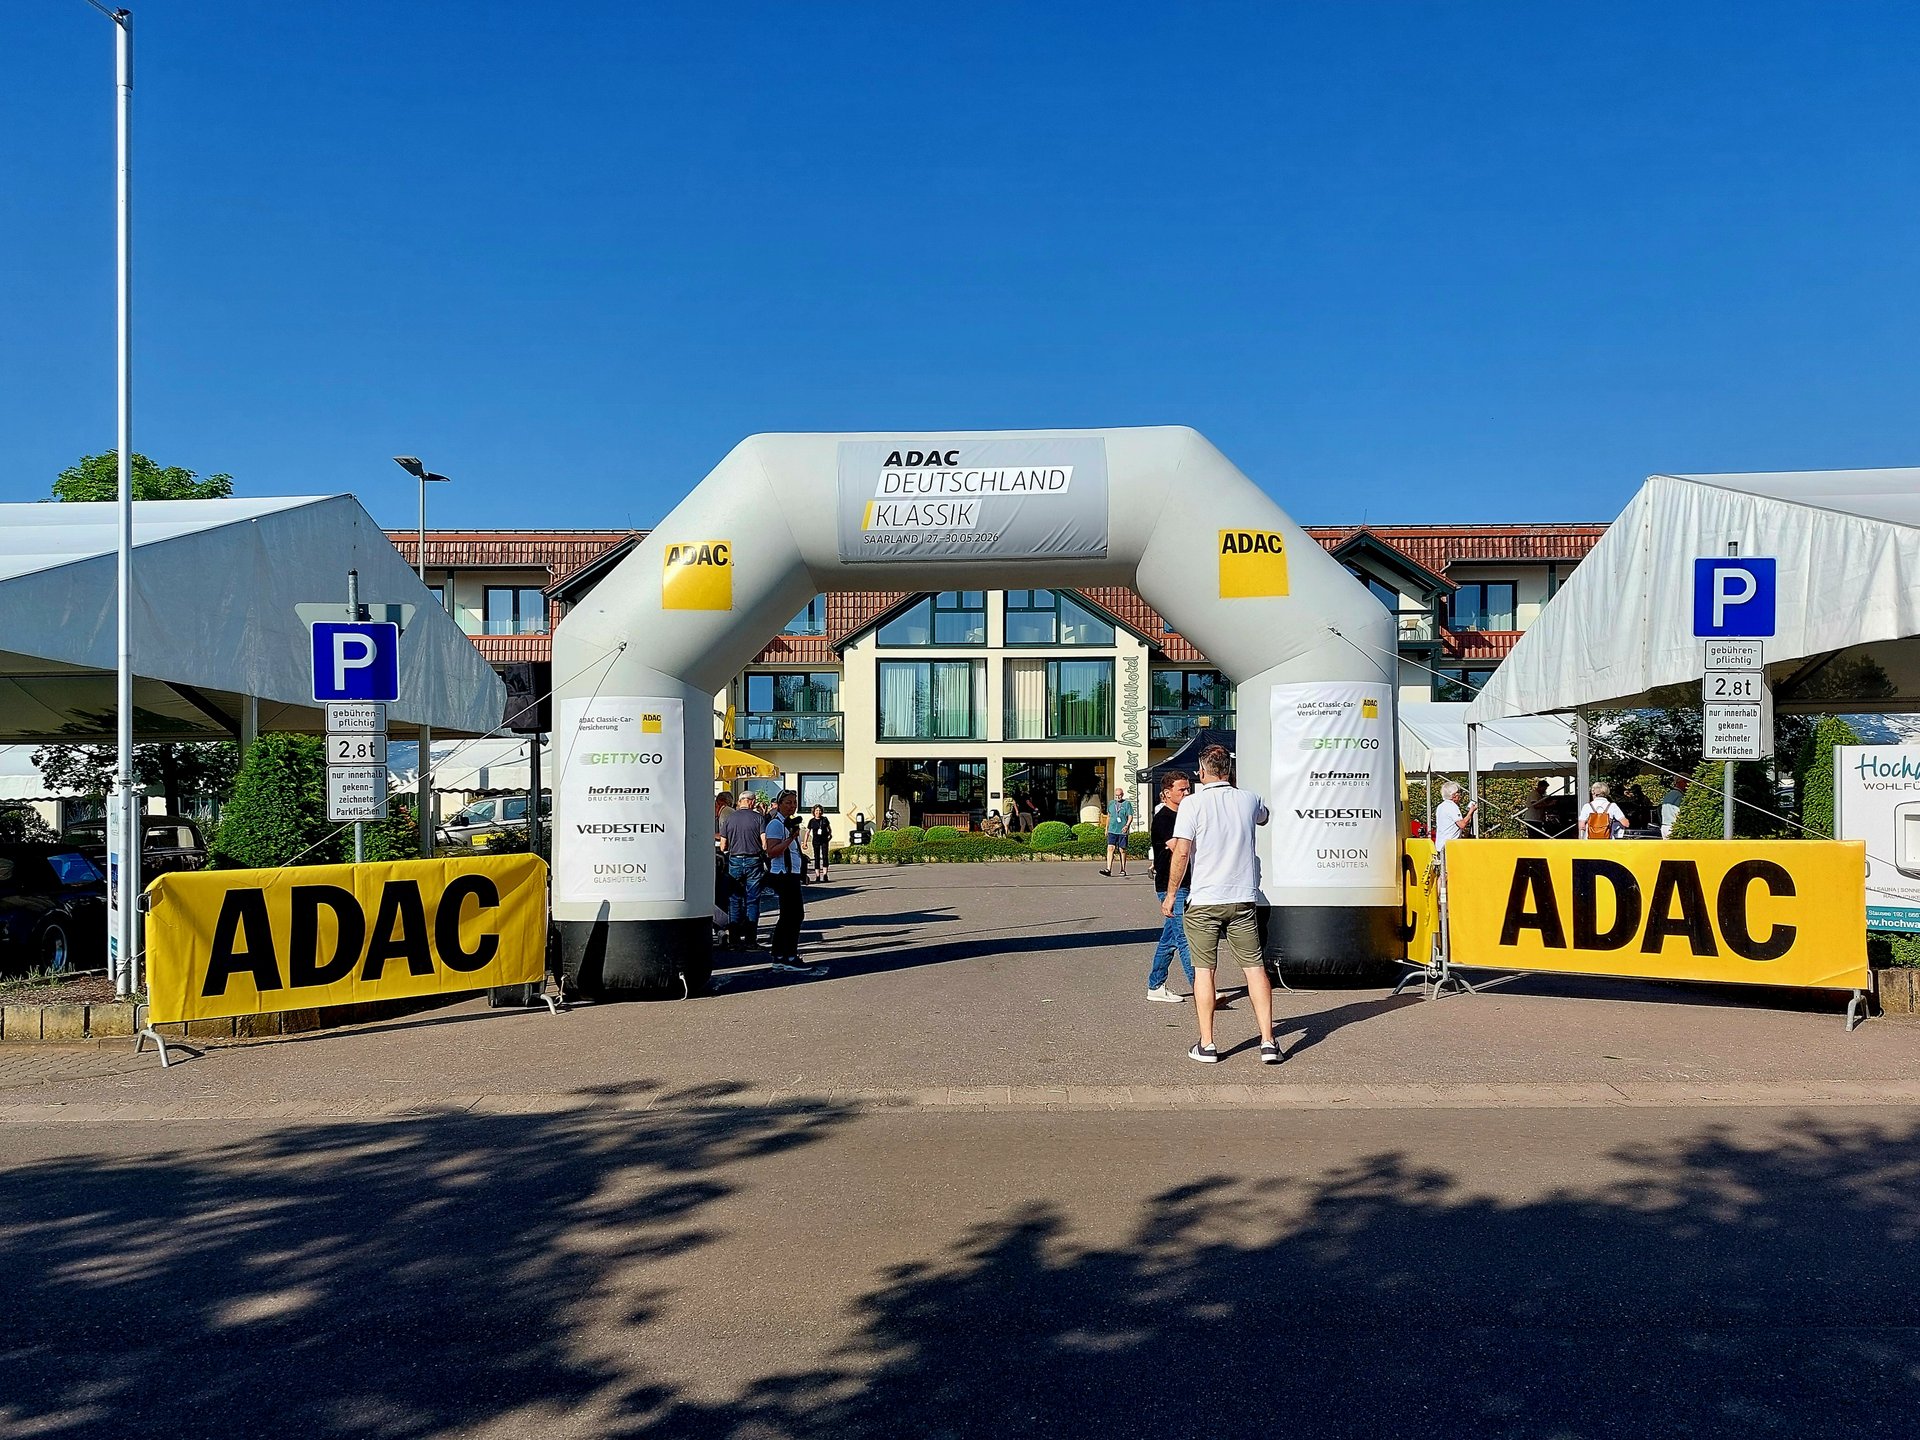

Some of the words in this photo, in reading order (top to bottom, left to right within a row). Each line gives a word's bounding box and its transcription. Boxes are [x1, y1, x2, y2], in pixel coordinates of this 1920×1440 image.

[883, 450, 960, 467] ADAC
[884, 469, 1065, 494] DEUTSCHLAND
[876, 502, 975, 527] KLASSIK
[864, 533, 918, 545] SAARLAND
[1222, 533, 1282, 554] ADAC
[666, 544, 729, 567] ADAC
[1712, 567, 1757, 628] P
[1711, 645, 1757, 656] gebühren-
[332, 632, 378, 691] P
[1716, 656, 1752, 666] pflichtig
[1118, 655, 1146, 748] Wohlfühlhotel
[1362, 699, 1378, 707] ADAC
[332, 709, 381, 719] gebühren-
[642, 714, 662, 722] ADAC
[1297, 709, 1342, 717] Versicherung
[1724, 708, 1758, 717] innerhalb
[338, 718, 375, 728] pflichtig
[596, 715, 634, 723] Classic-Car-
[579, 723, 619, 731] Versicherung
[1717, 721, 1748, 731] gekenn-
[1714, 733, 1751, 743] zeichneter
[1313, 738, 1380, 750] GETTYGO
[1711, 745, 1754, 755] Parkflächen
[591, 753, 663, 765] GETTYGO
[347, 770, 383, 779] innerhalb
[735, 766, 757, 776] ADAC
[1310, 770, 1370, 779] hofmann
[342, 782, 374, 793] gekenn-
[588, 785, 650, 794] hofmann
[338, 795, 378, 804] zeichneter
[336, 807, 380, 816] Parkflächen
[1294, 808, 1382, 819] VREDESTEIN
[576, 823, 665, 834] VREDESTEIN
[1316, 848, 1368, 860] UNION
[594, 863, 647, 874] UNION
[1499, 857, 1797, 961] ADAC
[201, 874, 500, 997] ADAC
